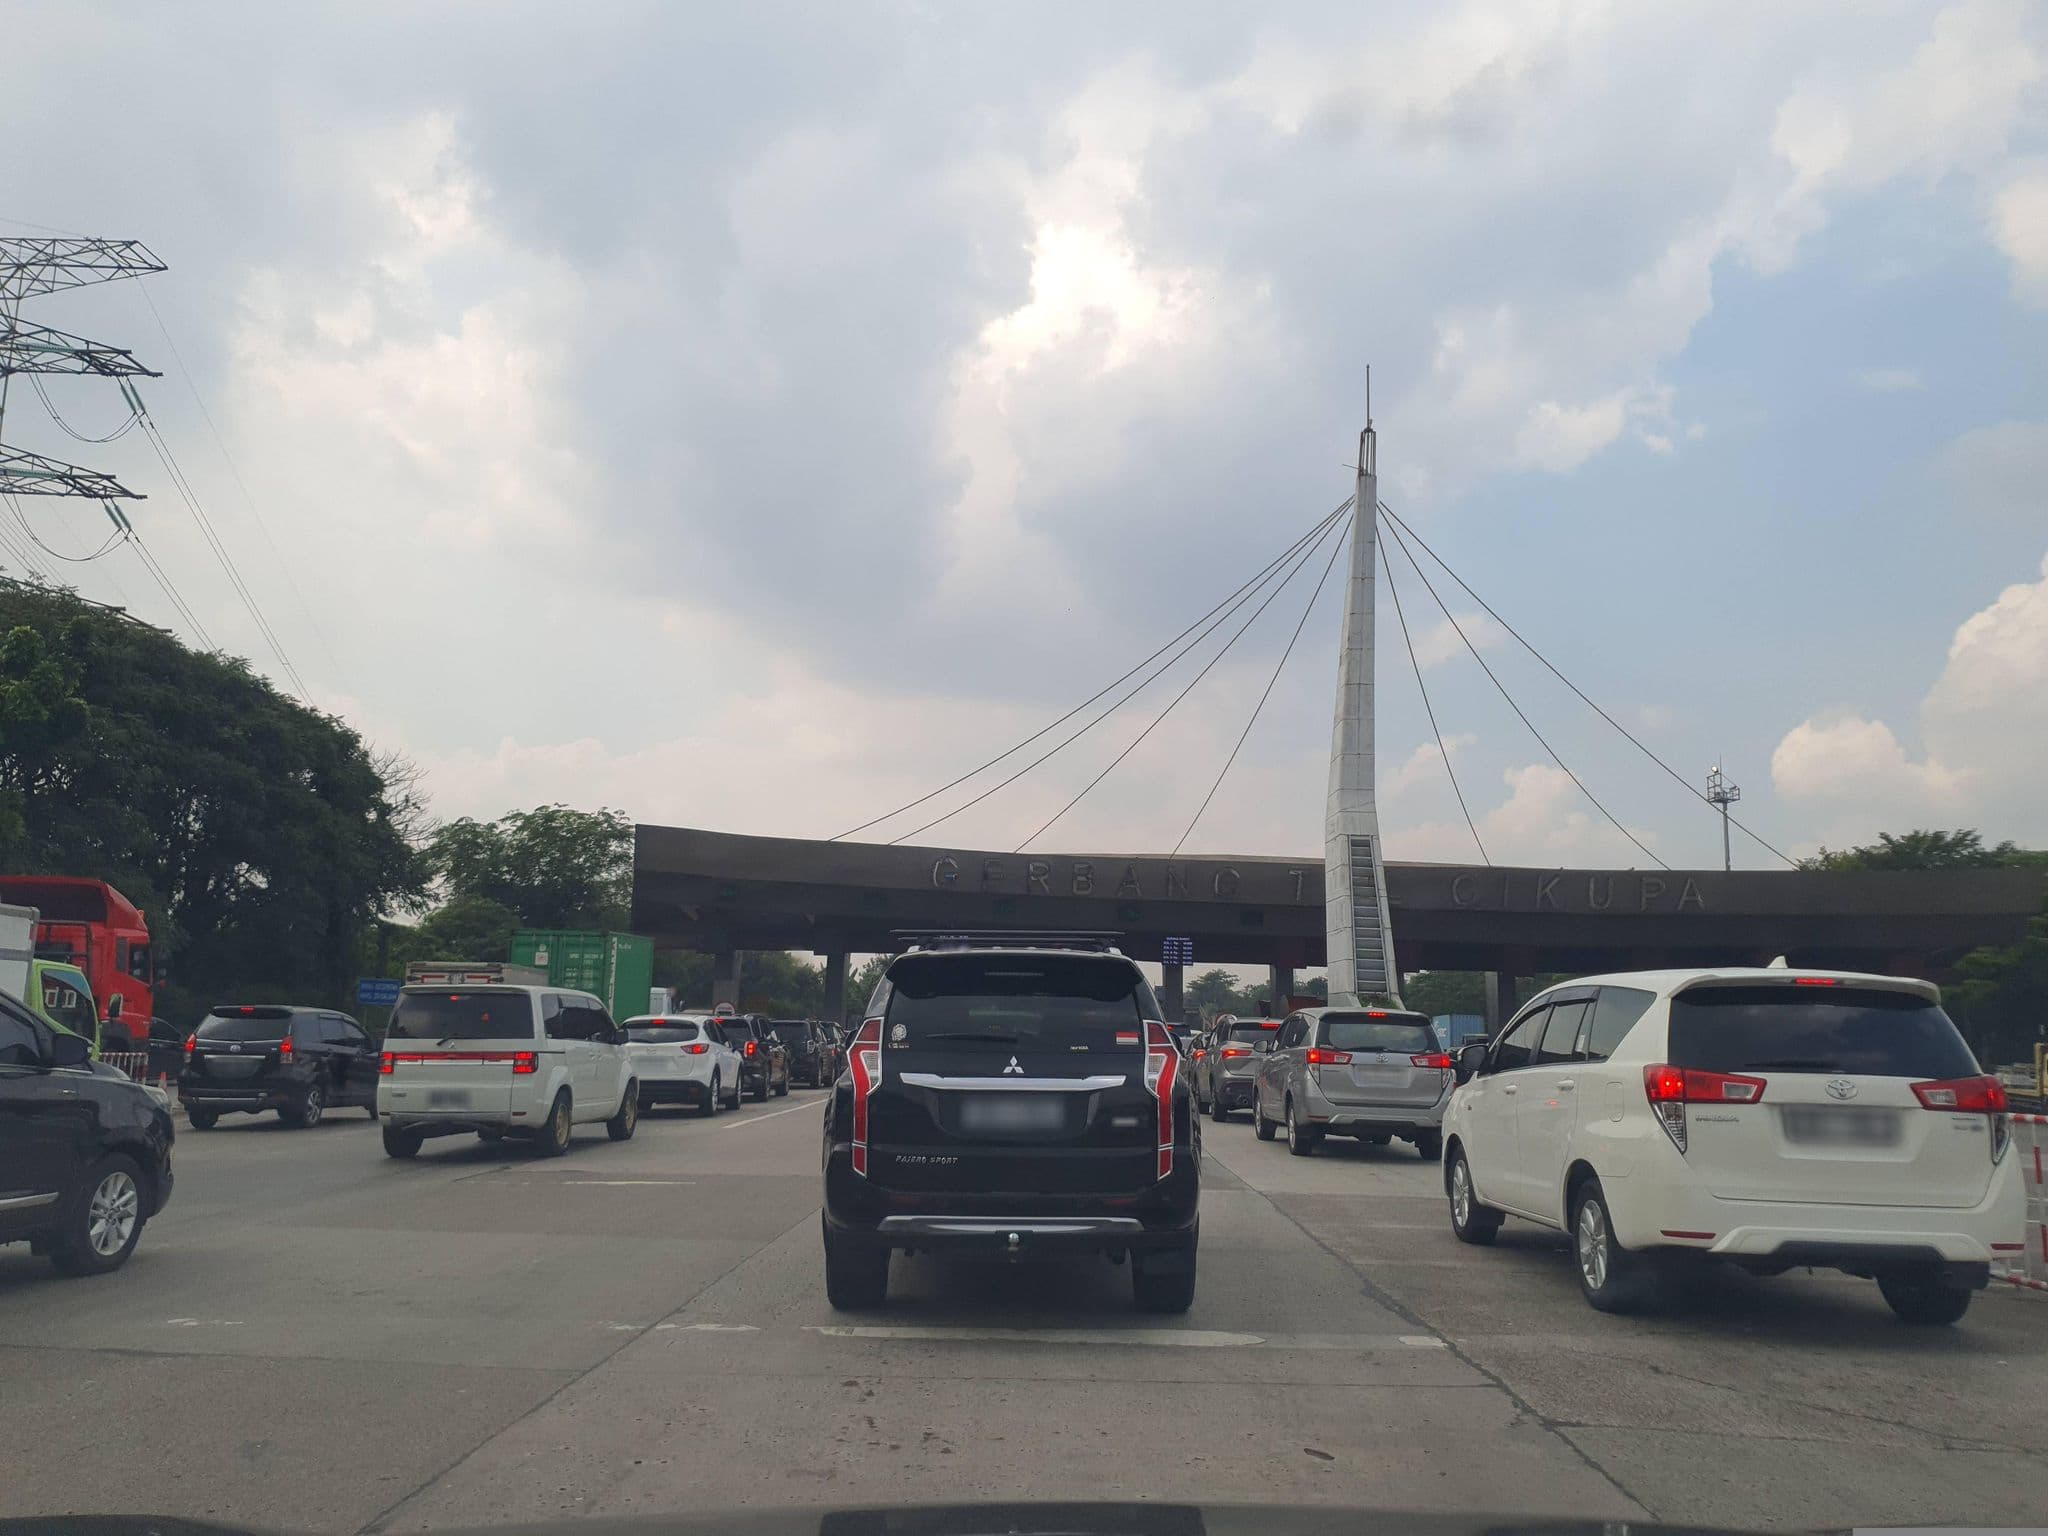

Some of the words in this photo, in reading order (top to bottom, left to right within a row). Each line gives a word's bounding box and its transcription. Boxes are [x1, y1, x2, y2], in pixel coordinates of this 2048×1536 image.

[932, 855, 1243, 900] GERBANG
[1451, 872, 1706, 912] CIKUPA
[895, 1155, 927, 1164] PAJERO
[929, 1156, 959, 1165] SPORT
